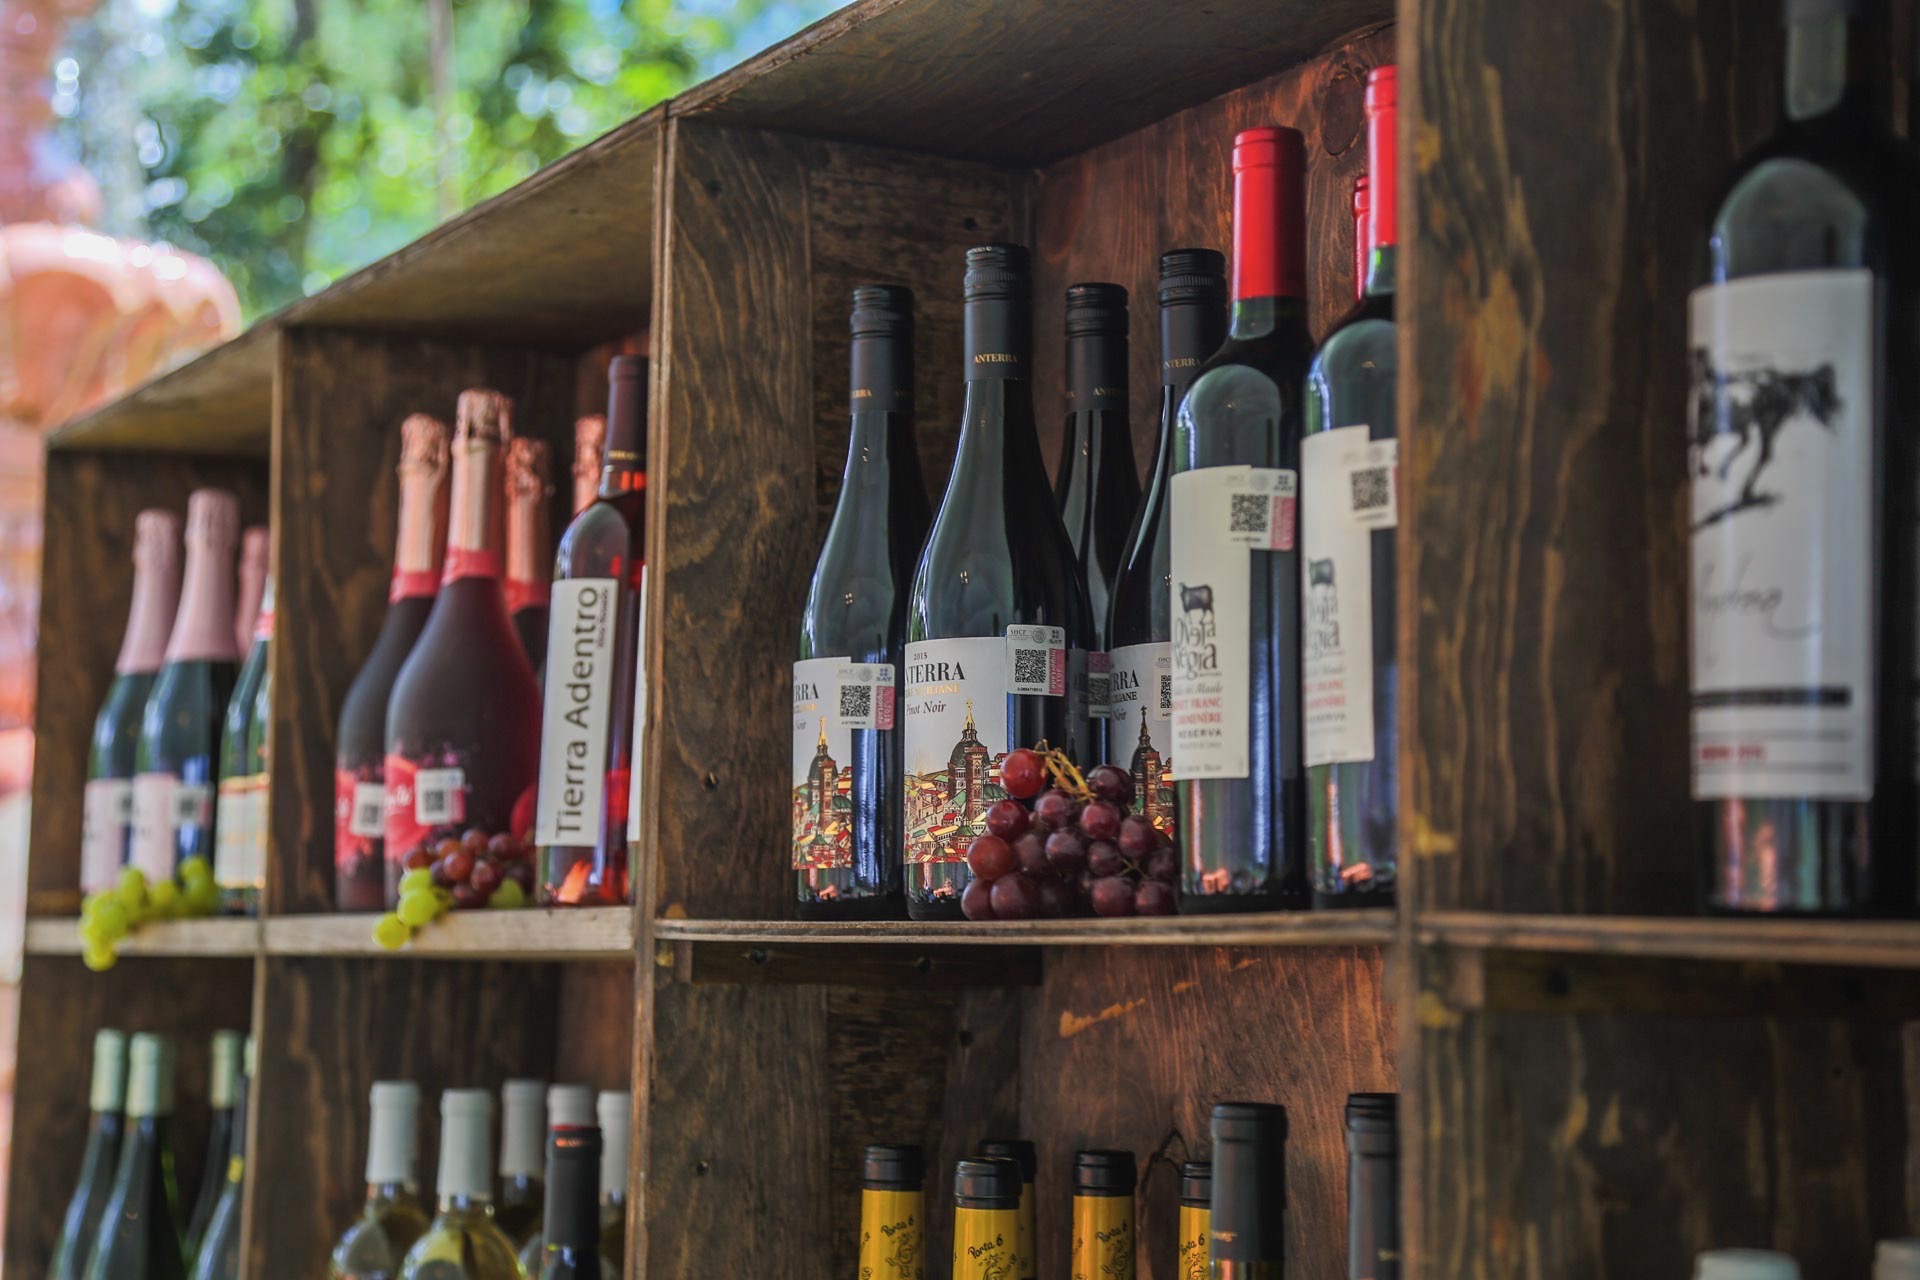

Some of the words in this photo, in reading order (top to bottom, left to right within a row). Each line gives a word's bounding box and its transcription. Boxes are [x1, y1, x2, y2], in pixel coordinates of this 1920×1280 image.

[974, 353, 1018, 364] ANTERRA
[564, 586, 599, 729] Adentro
[913, 652, 928, 661] 2015
[877, 686, 885, 725] Importado
[923, 700, 947, 714] Noir
[554, 740, 589, 839] Tierra
[968, 1242, 995, 1259] Porta
[996, 1233, 1003, 1247] 6
[1198, 1233, 1205, 1246] 6
